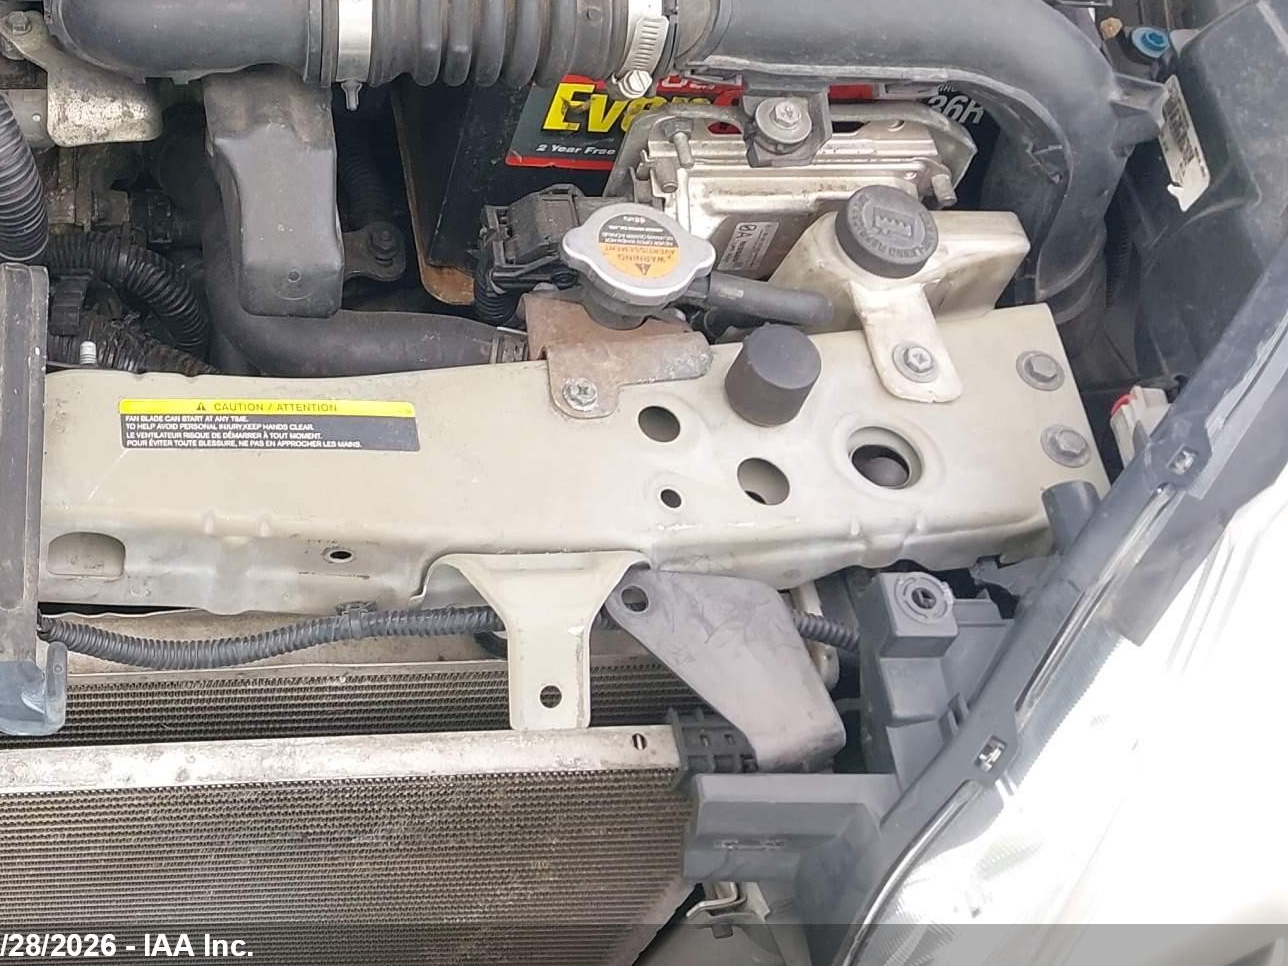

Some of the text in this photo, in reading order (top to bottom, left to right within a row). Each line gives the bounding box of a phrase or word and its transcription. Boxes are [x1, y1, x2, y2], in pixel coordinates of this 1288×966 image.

[536, 144, 616, 155] 2 Year Free
[617, 253, 666, 263] WARNING
[214, 402, 263, 411] CAUTION
[277, 403, 337, 412] ATTENTION
[222, 430, 262, 439] DÉMARRER
[149, 438, 173, 446] ÉVITER
[198, 439, 237, 447] BLESSURE,
